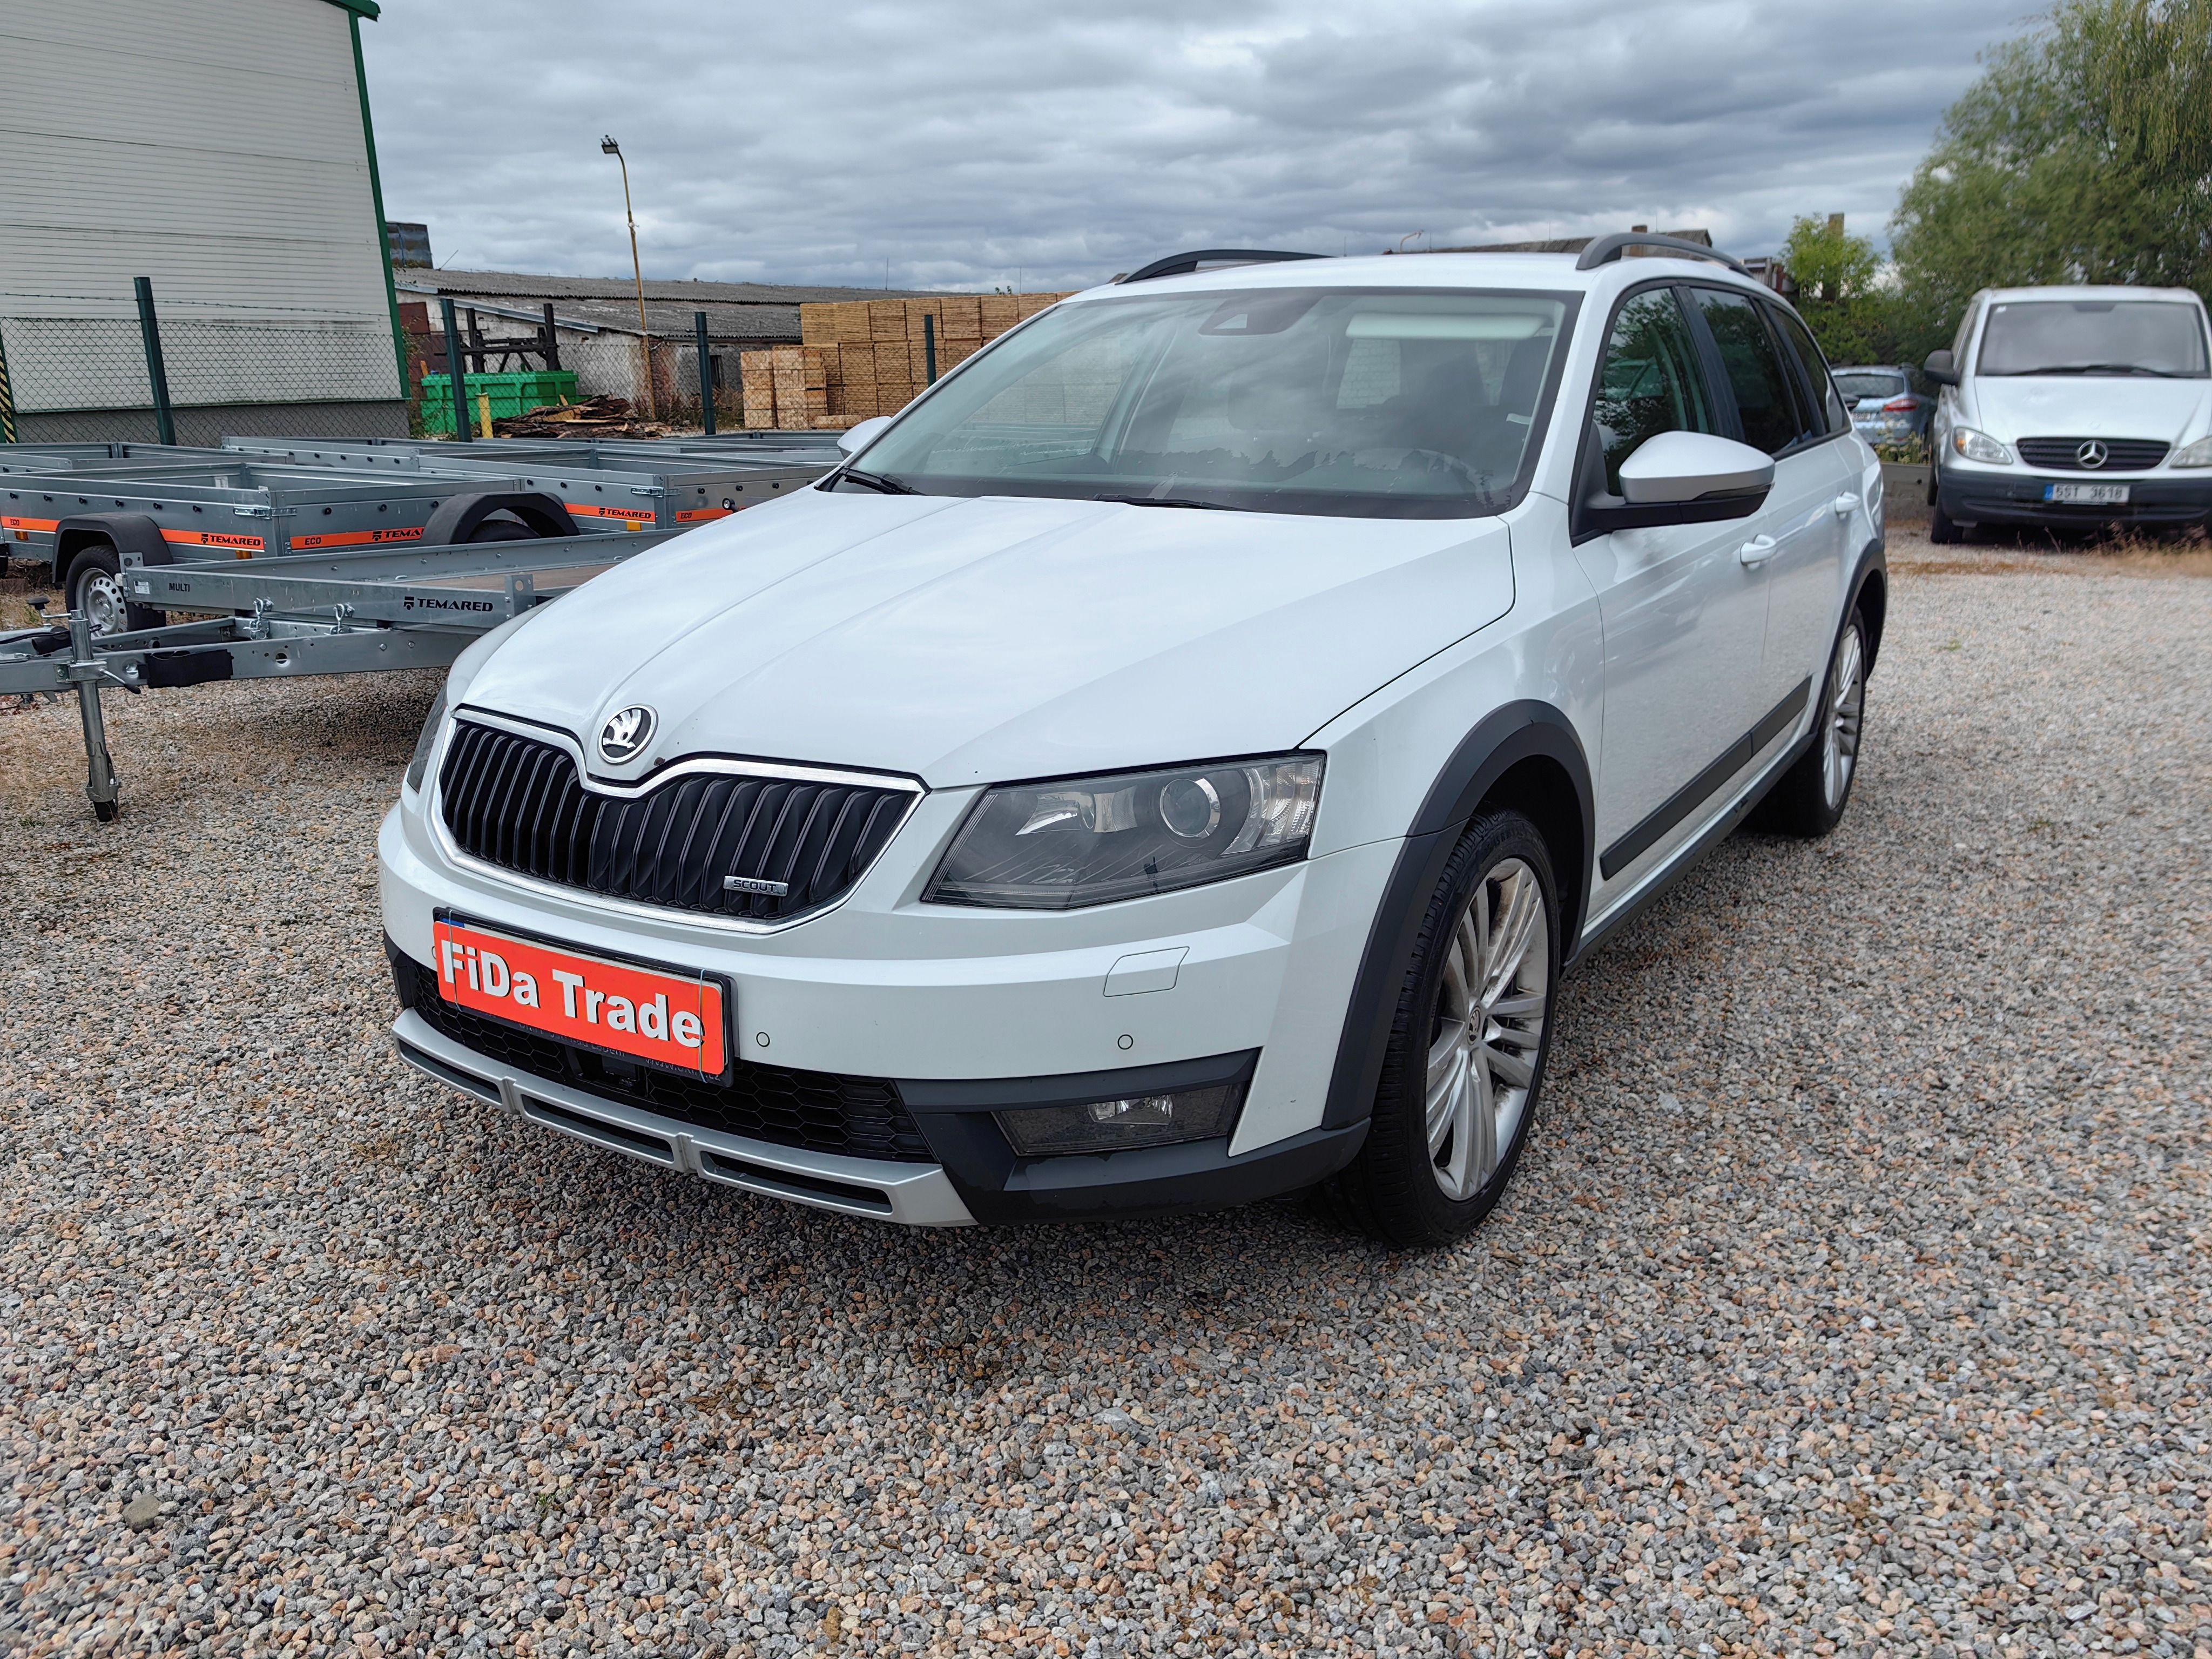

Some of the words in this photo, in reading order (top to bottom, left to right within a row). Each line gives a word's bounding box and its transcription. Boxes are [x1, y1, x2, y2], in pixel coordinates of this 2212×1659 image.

[606, 508, 651, 519] TEMARED
[210, 535, 261, 547] TEMARED
[304, 537, 321, 545] ECO
[169, 582, 190, 592] MULTI
[417, 598, 494, 612] TEMARED
[733, 879, 777, 893] SCOUT
[441, 939, 541, 1009] FiDa
[552, 968, 706, 1048] Trade
